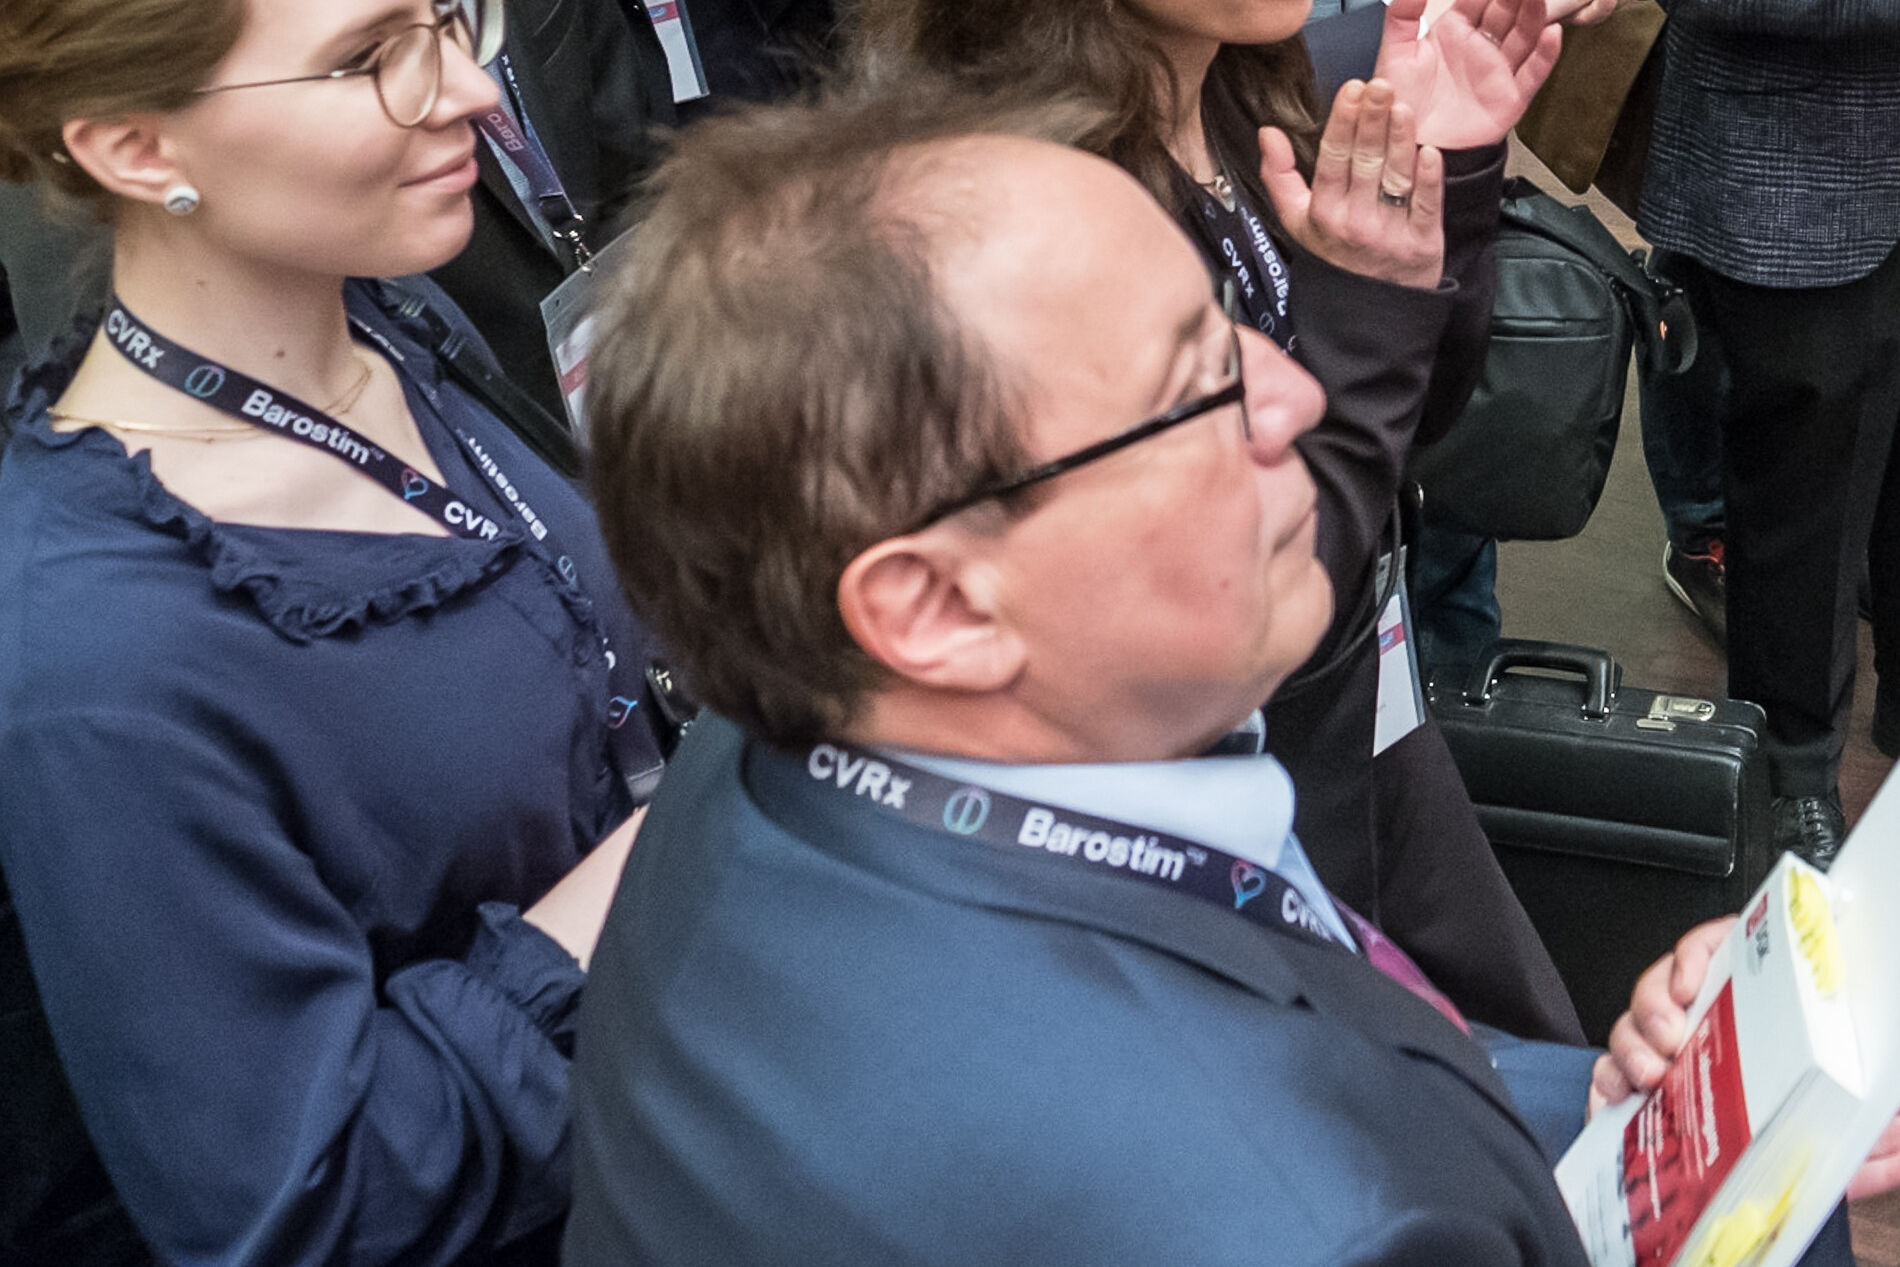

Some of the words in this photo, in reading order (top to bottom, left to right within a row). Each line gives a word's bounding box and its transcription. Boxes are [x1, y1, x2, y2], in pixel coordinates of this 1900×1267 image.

[1222, 237, 1255, 298] CVRx
[104, 307, 167, 371] CVRx
[806, 743, 912, 813] CVRx
